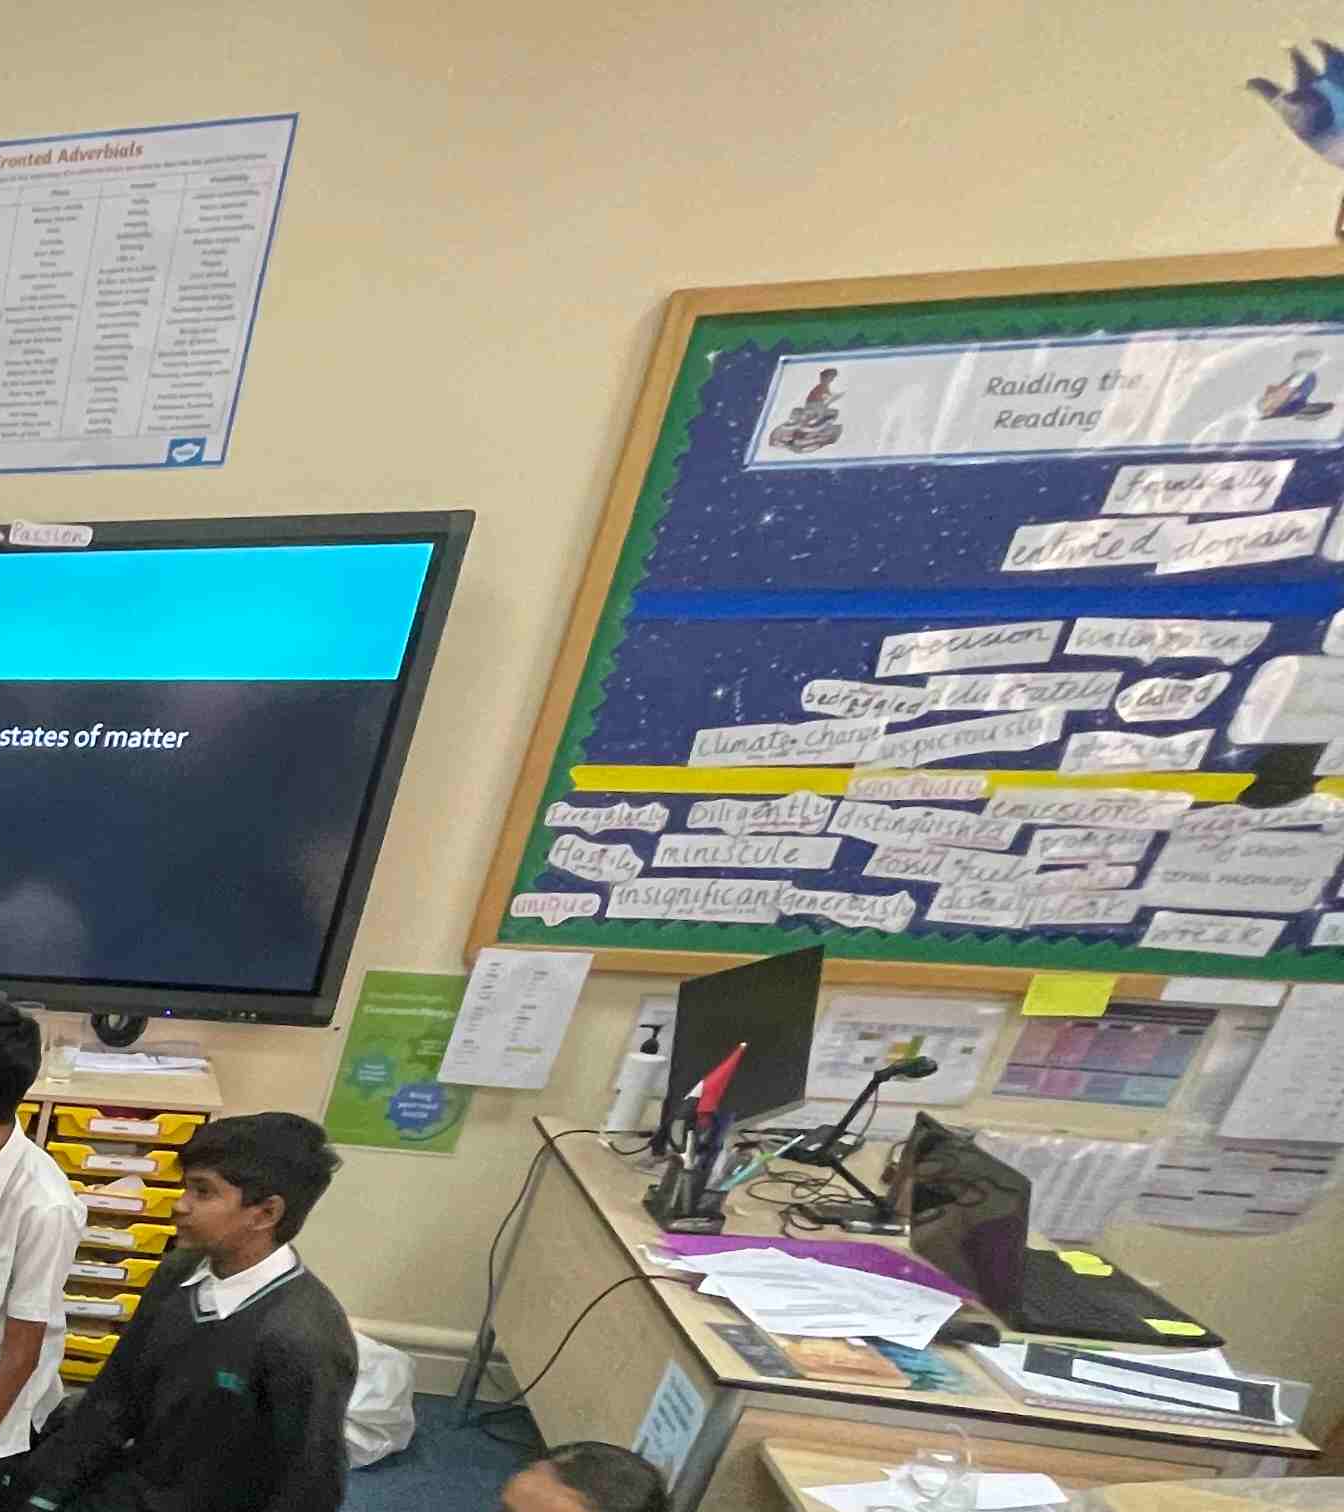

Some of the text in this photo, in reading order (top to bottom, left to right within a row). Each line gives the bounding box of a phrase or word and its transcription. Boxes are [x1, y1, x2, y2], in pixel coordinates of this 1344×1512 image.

[58, 140, 144, 164] Adverbials
[985, 371, 1087, 401] Raiding
[994, 407, 1105, 432] Reading
[12, 521, 89, 545] Passion
[0, 725, 69, 748] states
[74, 724, 103, 748] of
[104, 726, 189, 750] matter
